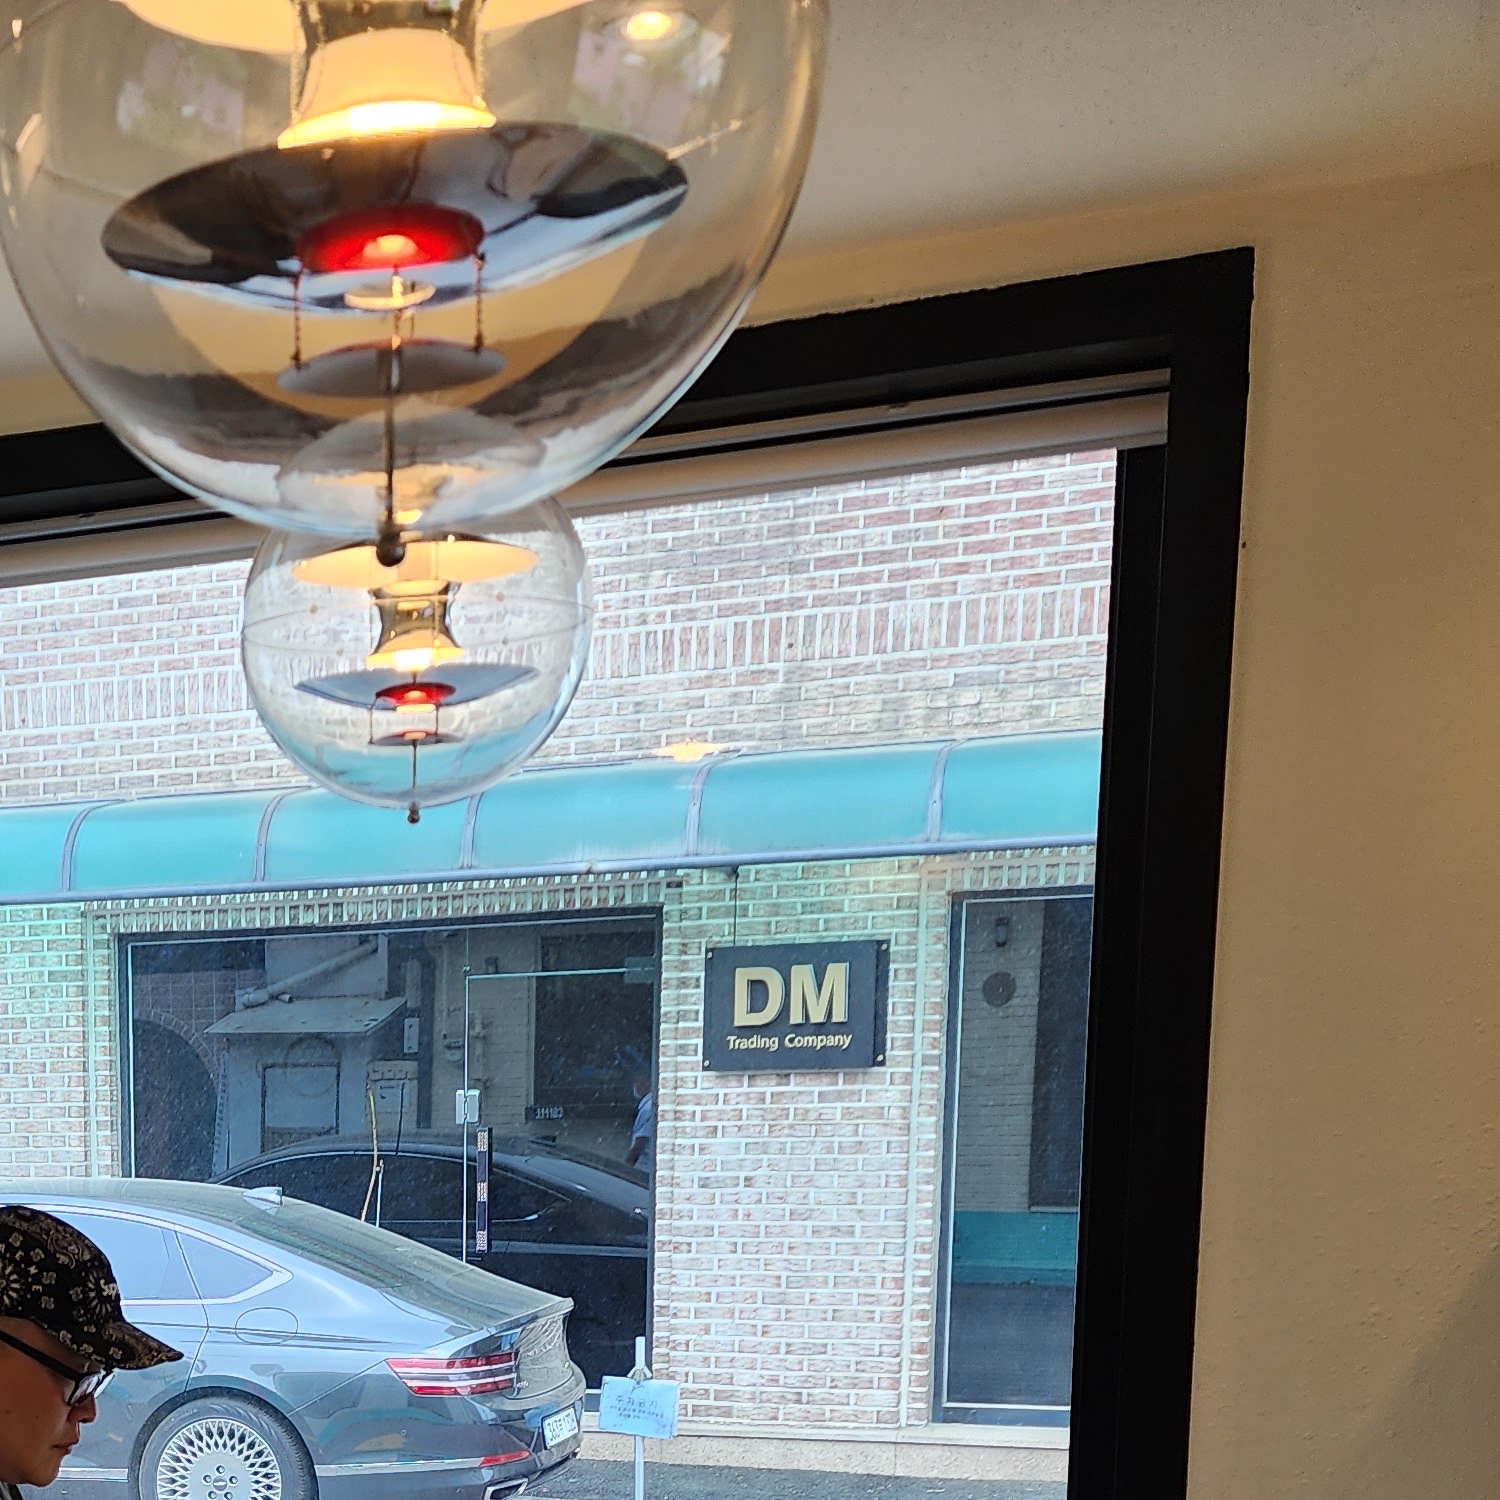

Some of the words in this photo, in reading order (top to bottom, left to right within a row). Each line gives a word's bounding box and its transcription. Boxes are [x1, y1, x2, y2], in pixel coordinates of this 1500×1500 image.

[733, 961, 850, 1027] DM
[726, 1034, 779, 1052] Trading
[784, 1033, 852, 1051] Company
[100, 1279, 118, 1300] Sup
